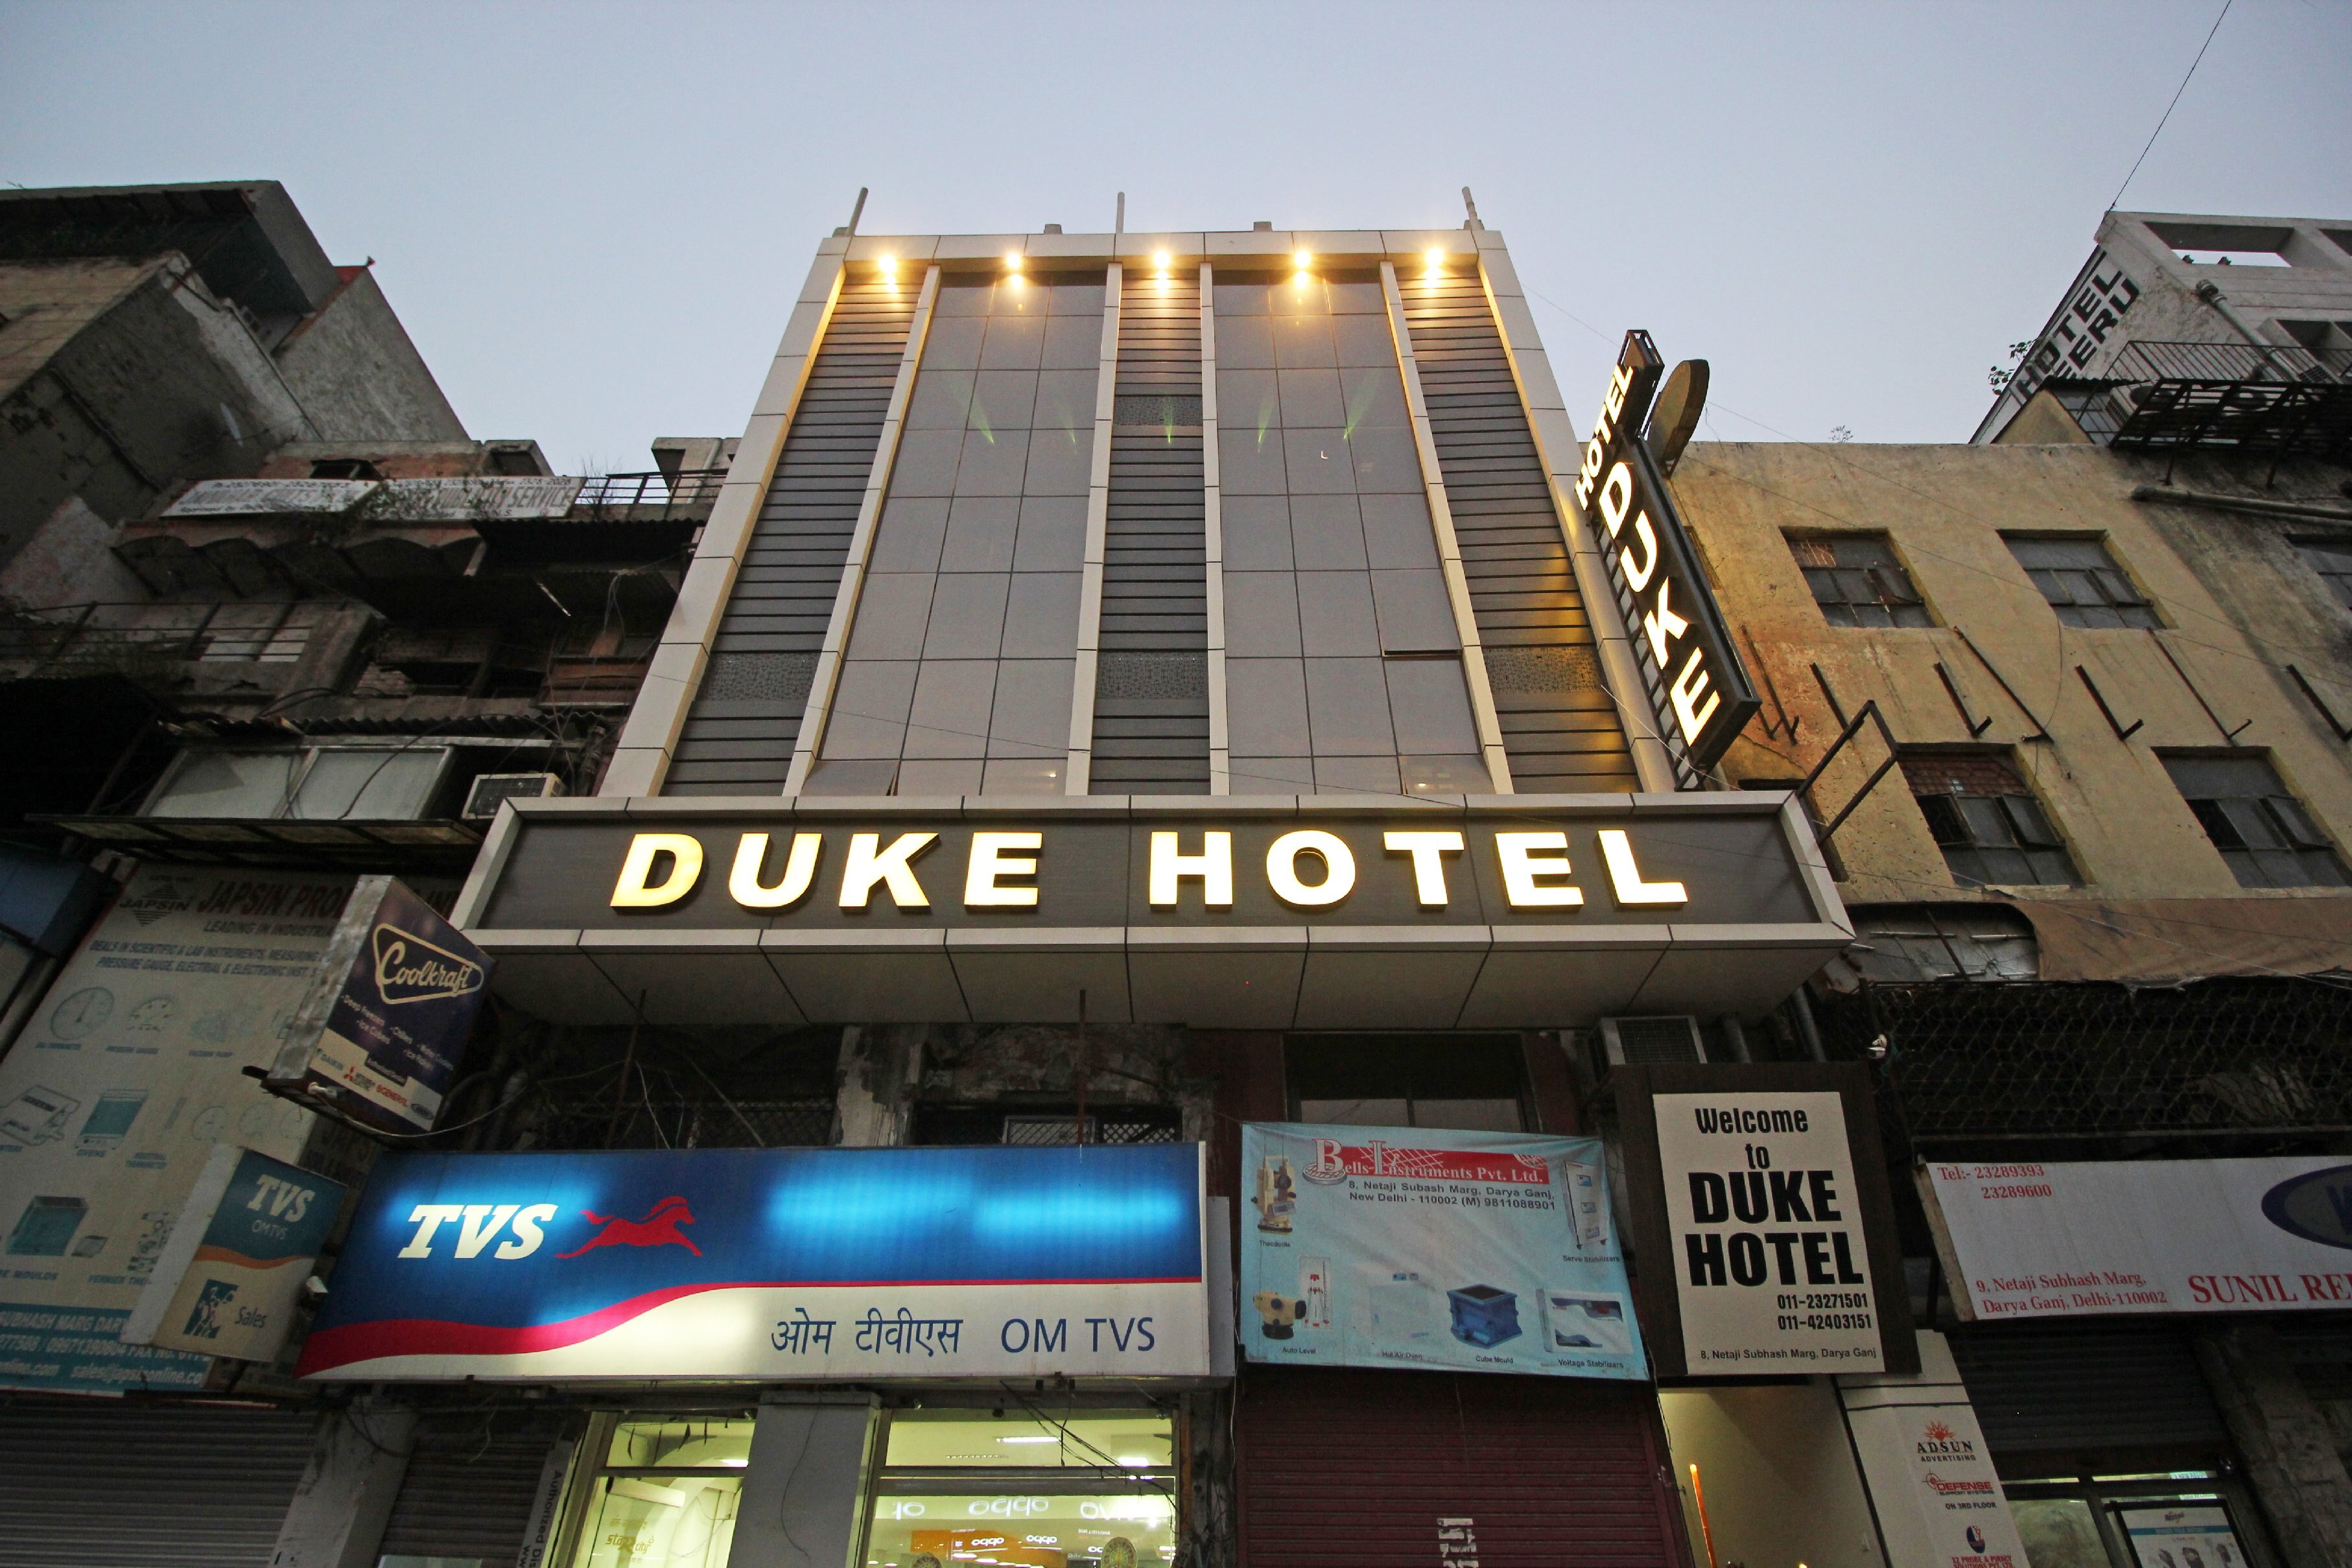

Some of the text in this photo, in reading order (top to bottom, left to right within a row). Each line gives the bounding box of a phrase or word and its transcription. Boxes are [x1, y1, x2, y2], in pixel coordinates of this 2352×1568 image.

[2015, 270, 2122, 400] HOTEL
[1574, 364, 1634, 512] HOTEL
[1599, 461, 1720, 747] DUKE
[611, 830, 1689, 909] DUKE HOTEL
[379, 941, 469, 996] Coolkraft
[1695, 1108, 1809, 1134] Welcome
[1745, 1143, 1770, 1169] to
[1477, 1168, 1507, 1182] Pvt.
[1512, 1169, 1544, 1183] Ltd.
[248, 1174, 316, 1223] TVS
[1349, 1193, 1374, 1201] New
[1378, 1193, 1407, 1203] Delhi
[1419, 1195, 1458, 1205] 110002
[1461, 1197, 1481, 1208] (M)
[1364, 1182, 1396, 1192] Netaji
[1402, 1183, 1444, 1193] Subash
[1486, 1187, 1522, 1199] Darya
[1688, 1170, 1842, 1224] DUKE
[397, 1204, 559, 1259] TVS
[1685, 1232, 1864, 1287] HOTEL
[1993, 1276, 2037, 1293] Netaji
[2039, 1272, 2102, 1289] Subhash
[2188, 1274, 2298, 1304] SUNIL
[1777, 1293, 1868, 1309] 011-23271501
[1982, 1298, 2028, 1315] Darya
[2073, 1291, 2168, 1307] Delhi-110002
[235, 1306, 267, 1328] Sales
[1778, 1314, 1872, 1330] 011-42403151
[771, 1307, 964, 1357] ओम टीवीएस
[1001, 1317, 1156, 1353] OM TVS
[1558, 1359, 1586, 1368] Voltage
[1712, 1350, 1741, 1361] Netaji
[1743, 1349, 1788, 1359] Subhash
[1791, 1349, 1819, 1360] Marg,
[1821, 1348, 1851, 1360] Darya
[1853, 1348, 1877, 1359] Ganj
[1917, 1441, 1973, 1453] ADSUN
[1936, 1481, 1993, 1491] DEFENSE
[535, 1470, 562, 1543] Authorized
